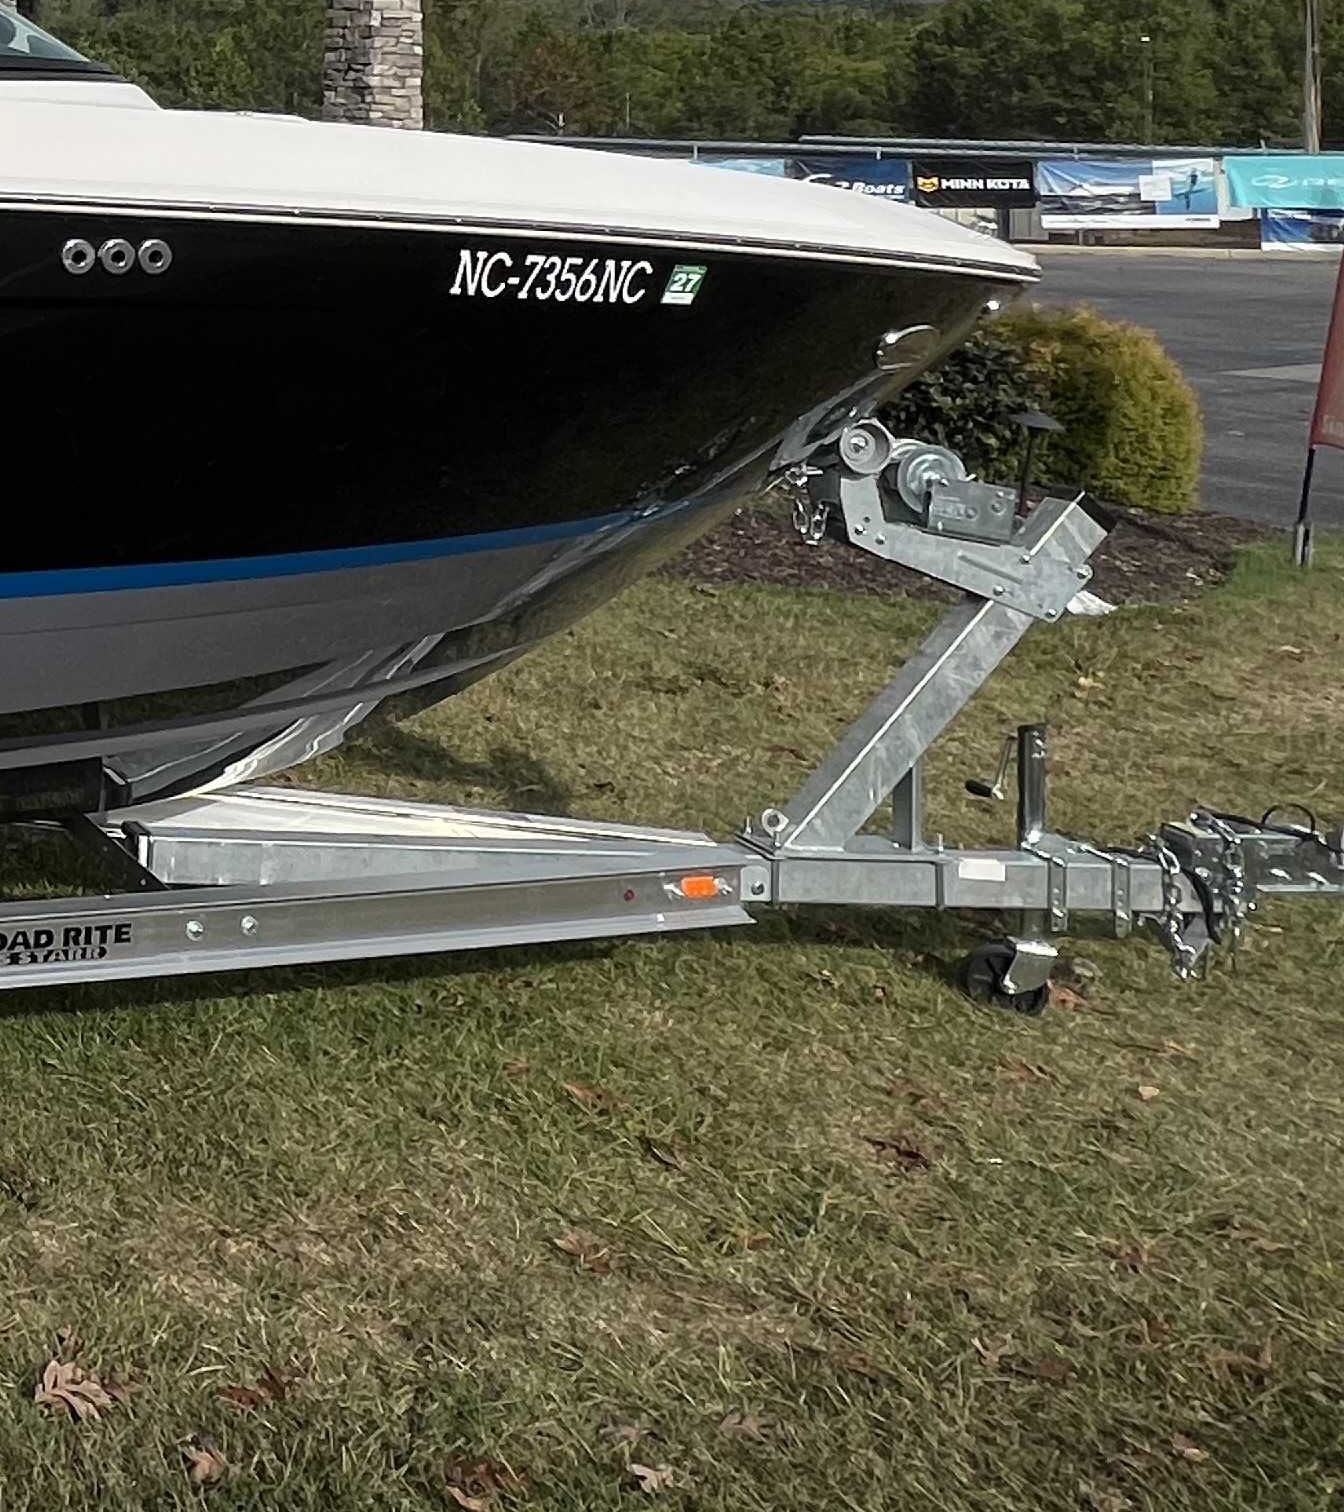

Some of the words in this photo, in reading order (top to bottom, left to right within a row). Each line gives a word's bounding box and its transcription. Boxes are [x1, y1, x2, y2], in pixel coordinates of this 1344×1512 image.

[940, 177, 984, 189] MINN
[986, 178, 1030, 190] KOTA
[449, 248, 653, 304] NC-7356NC
[670, 272, 701, 292] 27
[63, 922, 132, 947] RITE
